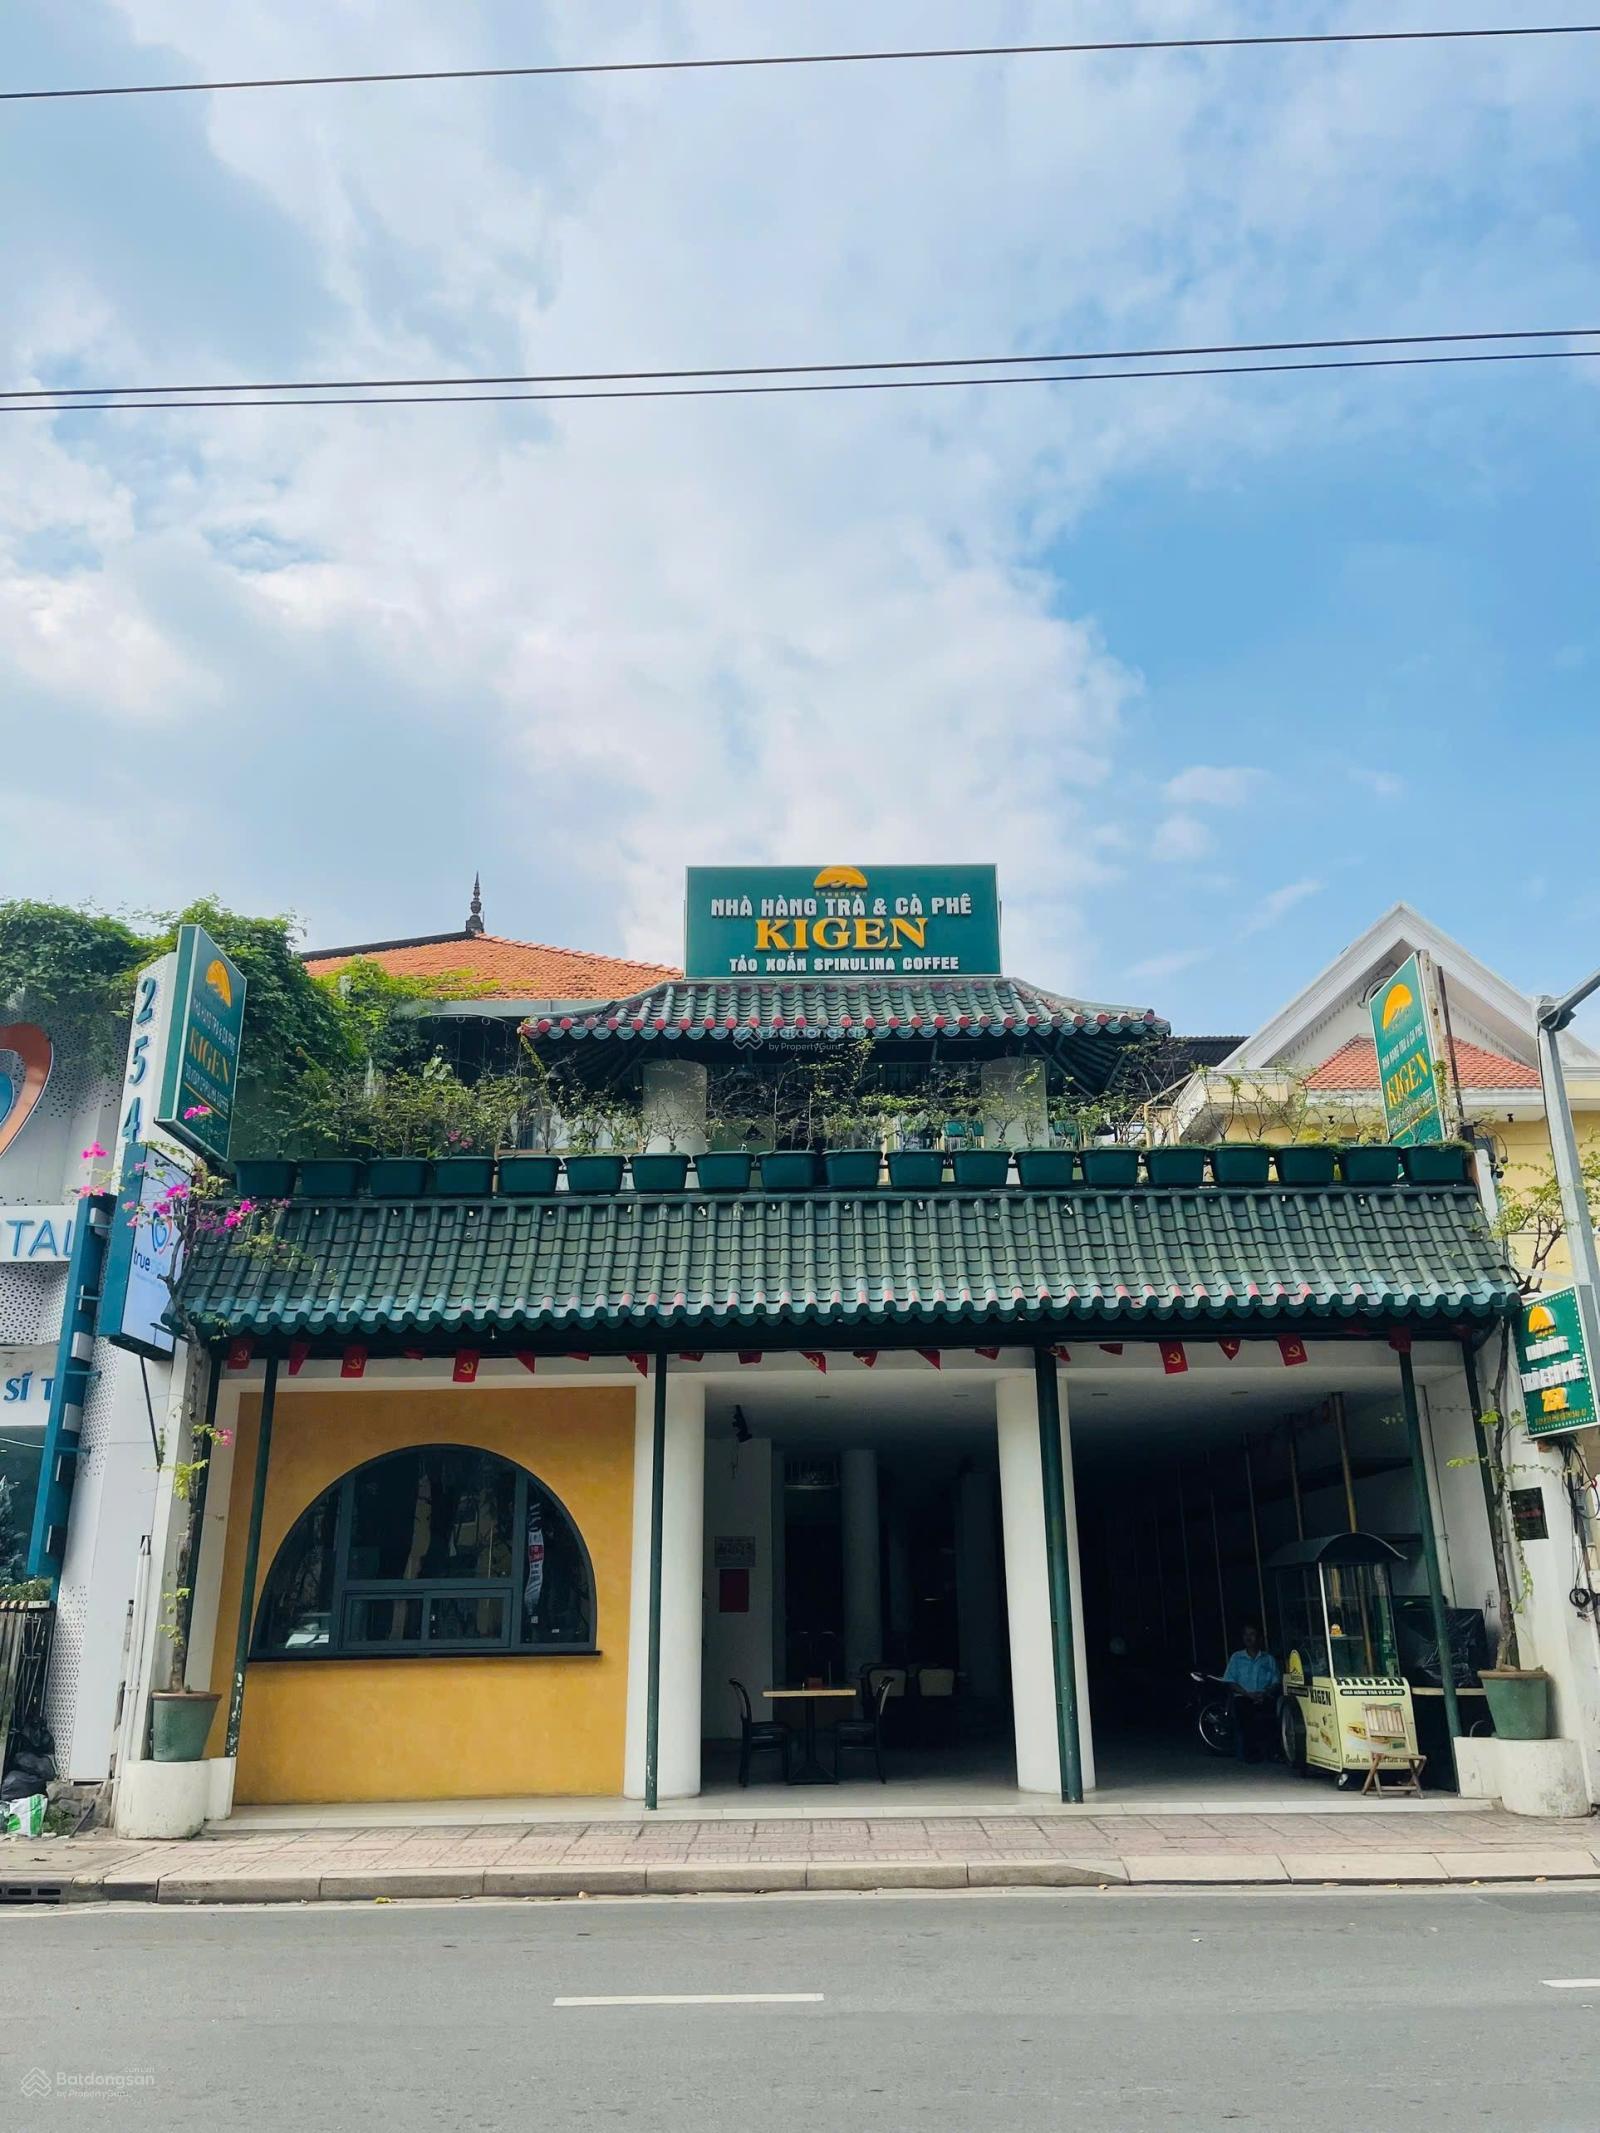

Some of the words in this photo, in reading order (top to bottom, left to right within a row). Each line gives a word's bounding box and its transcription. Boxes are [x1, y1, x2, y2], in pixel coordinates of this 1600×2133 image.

[711, 895, 753, 916] NHÀ
[761, 894, 817, 917] HÀNG
[825, 894, 866, 916] TRÀ
[873, 897, 888, 916] &
[895, 893, 923, 915] CÀ
[931, 892, 972, 914] PHÊ
[754, 917, 928, 951] KIGEN
[766, 952, 807, 972] XOẮN
[814, 957, 896, 971] SPIRULINA
[902, 956, 959, 970] COFFEE
[189, 1027, 231, 1087] KIGEN
[1385, 1049, 1428, 1110] KIGEN
